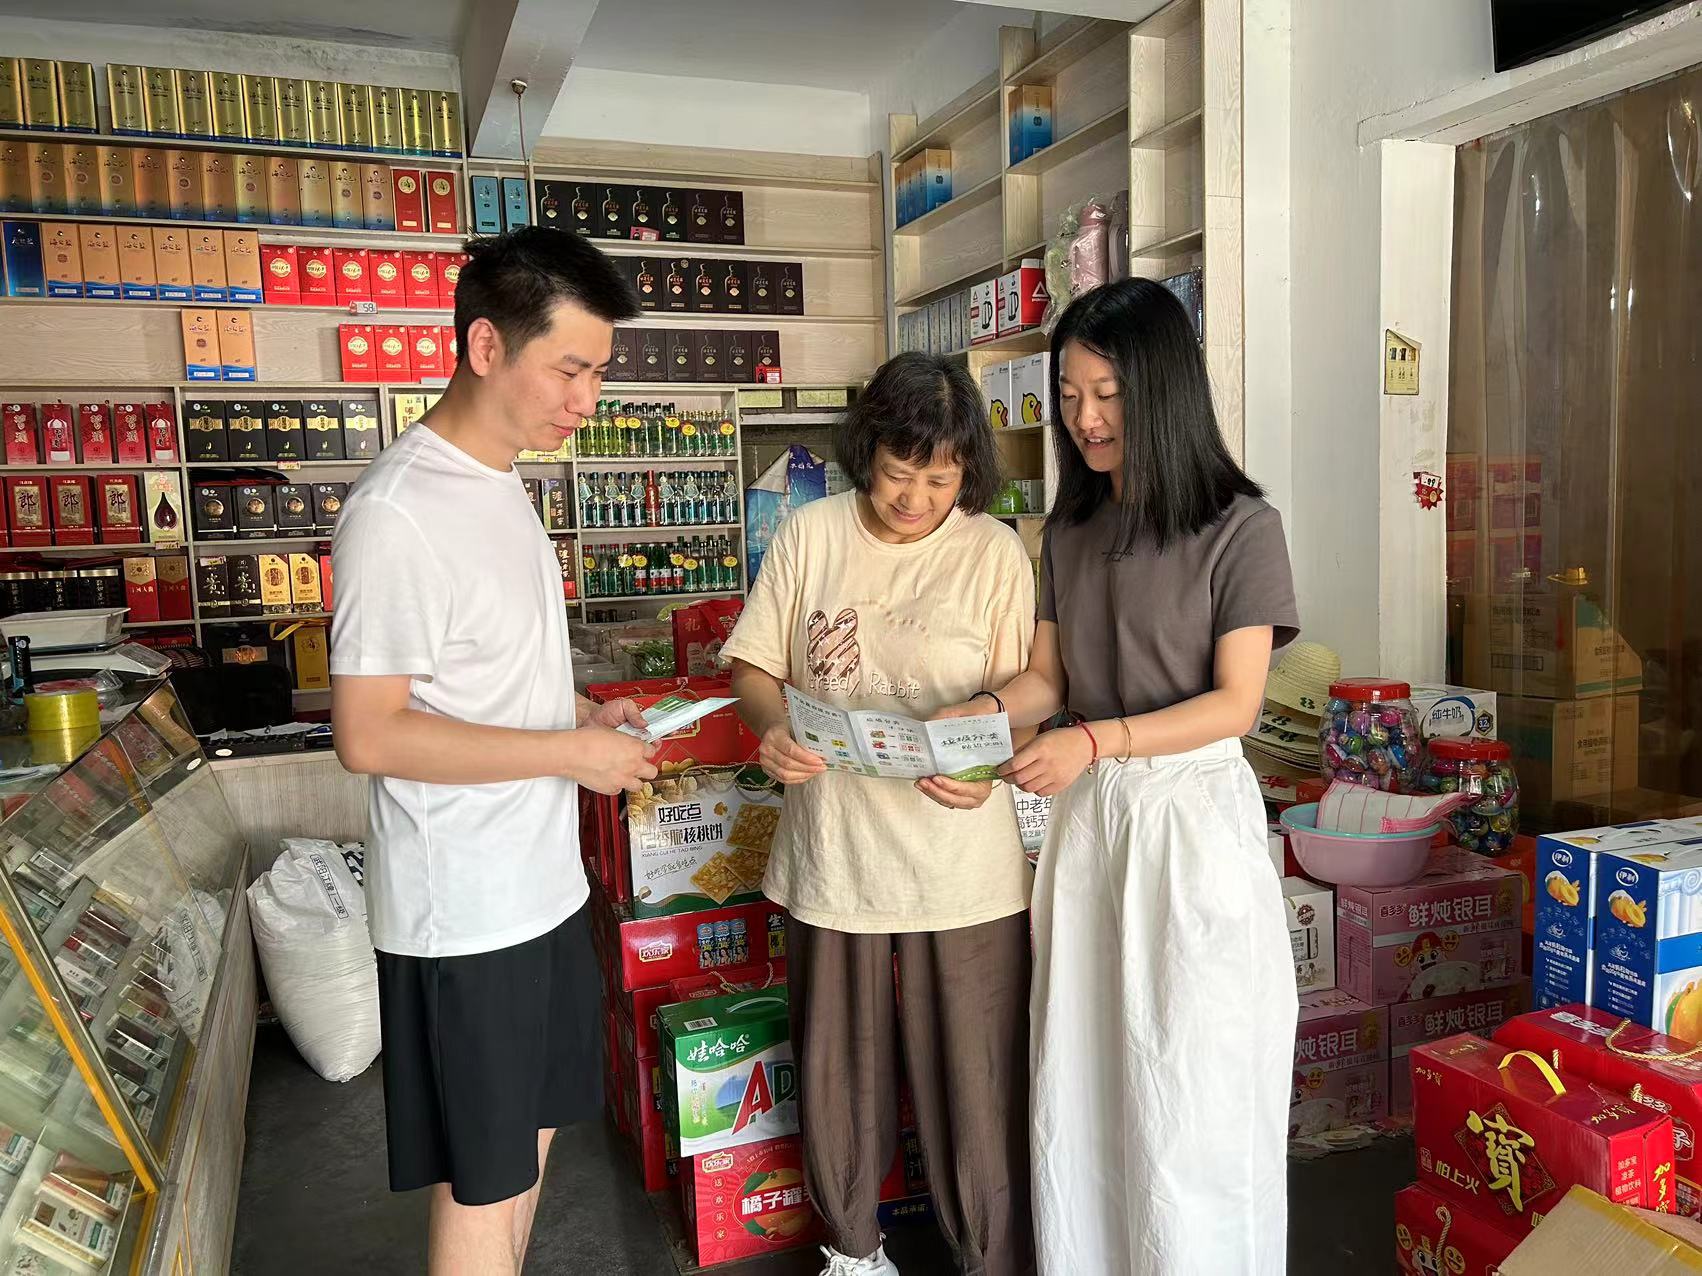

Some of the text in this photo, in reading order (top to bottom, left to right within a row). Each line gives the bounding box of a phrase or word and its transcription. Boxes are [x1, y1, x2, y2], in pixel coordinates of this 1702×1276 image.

[868, 671, 921, 699] Rabbit
[658, 803, 702, 824] 好吃点
[768, 913, 784, 927] 生
[1408, 894, 1493, 928] 鲜炖银耳
[1425, 1000, 1504, 1036] 鲜炖银耳
[686, 1034, 750, 1063] 娃哈哈
[731, 1060, 796, 1135] AD
[1435, 1159, 1480, 1195] 怕上火
